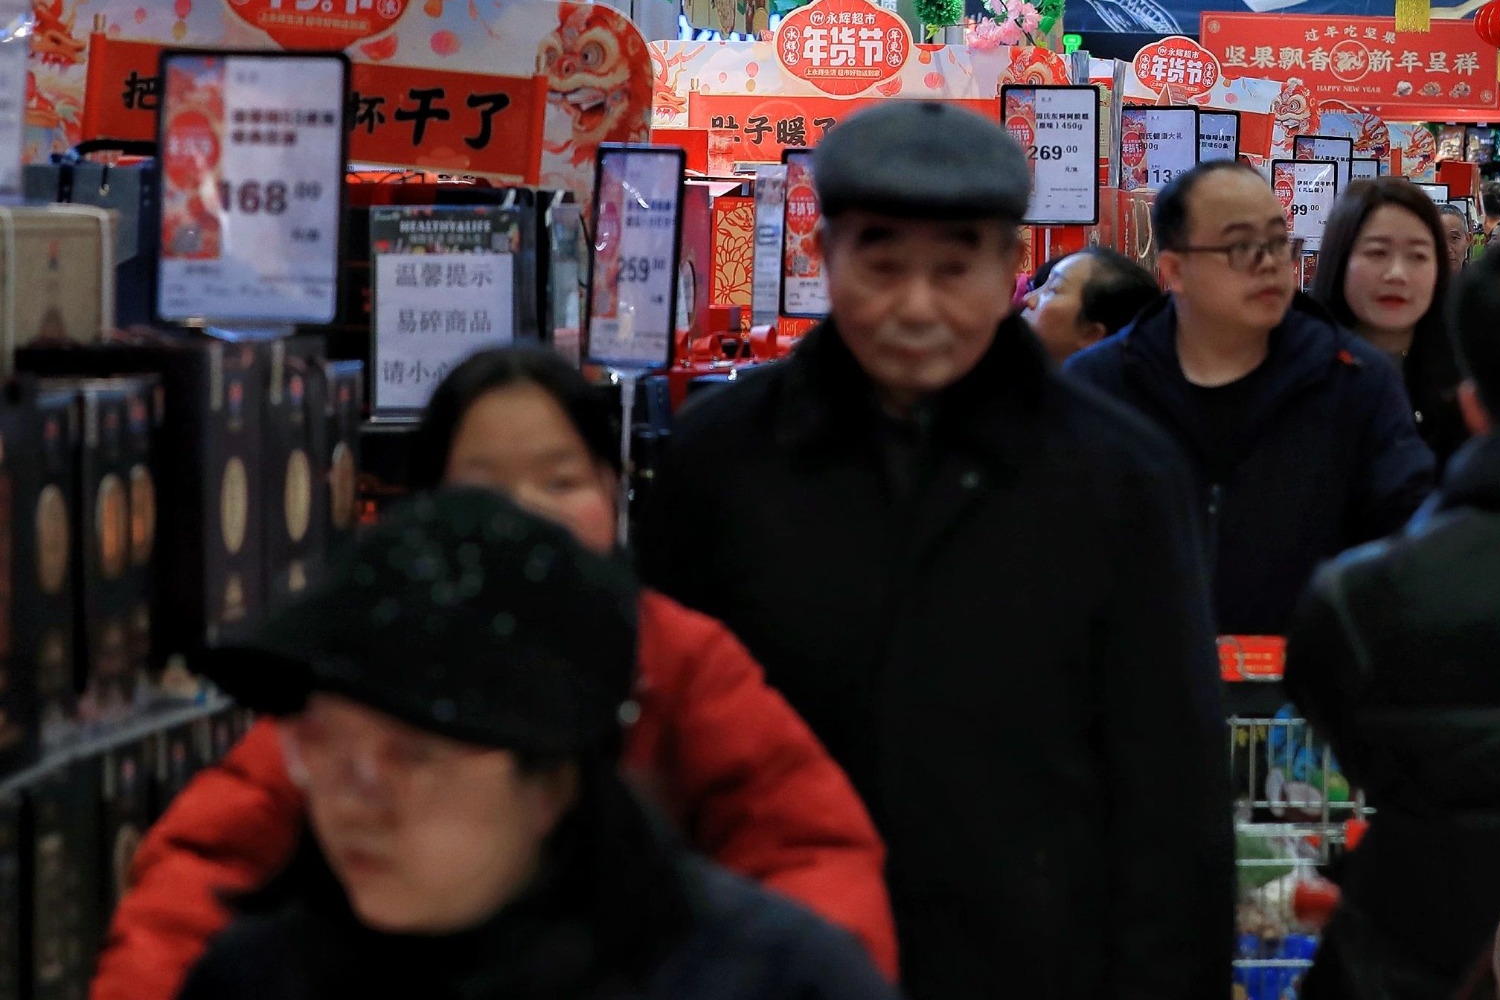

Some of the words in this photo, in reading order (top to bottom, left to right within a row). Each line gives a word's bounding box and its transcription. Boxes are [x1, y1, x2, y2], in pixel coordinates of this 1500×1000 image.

[826, 12, 877, 25] 永辉超市
[802, 26, 883, 67] 年货节
[1304, 25, 1397, 45] 过年吃坚果
[1150, 55, 1204, 85] 年货节
[1221, 47, 1330, 72] 坚果飘香
[1368, 48, 1481, 77] 新年呈祥
[1315, 84, 1341, 92] HAPPY
[1362, 85, 1381, 93] YEAR
[395, 262, 493, 288] 温馨提示
[398, 309, 492, 333] 易碎商品
